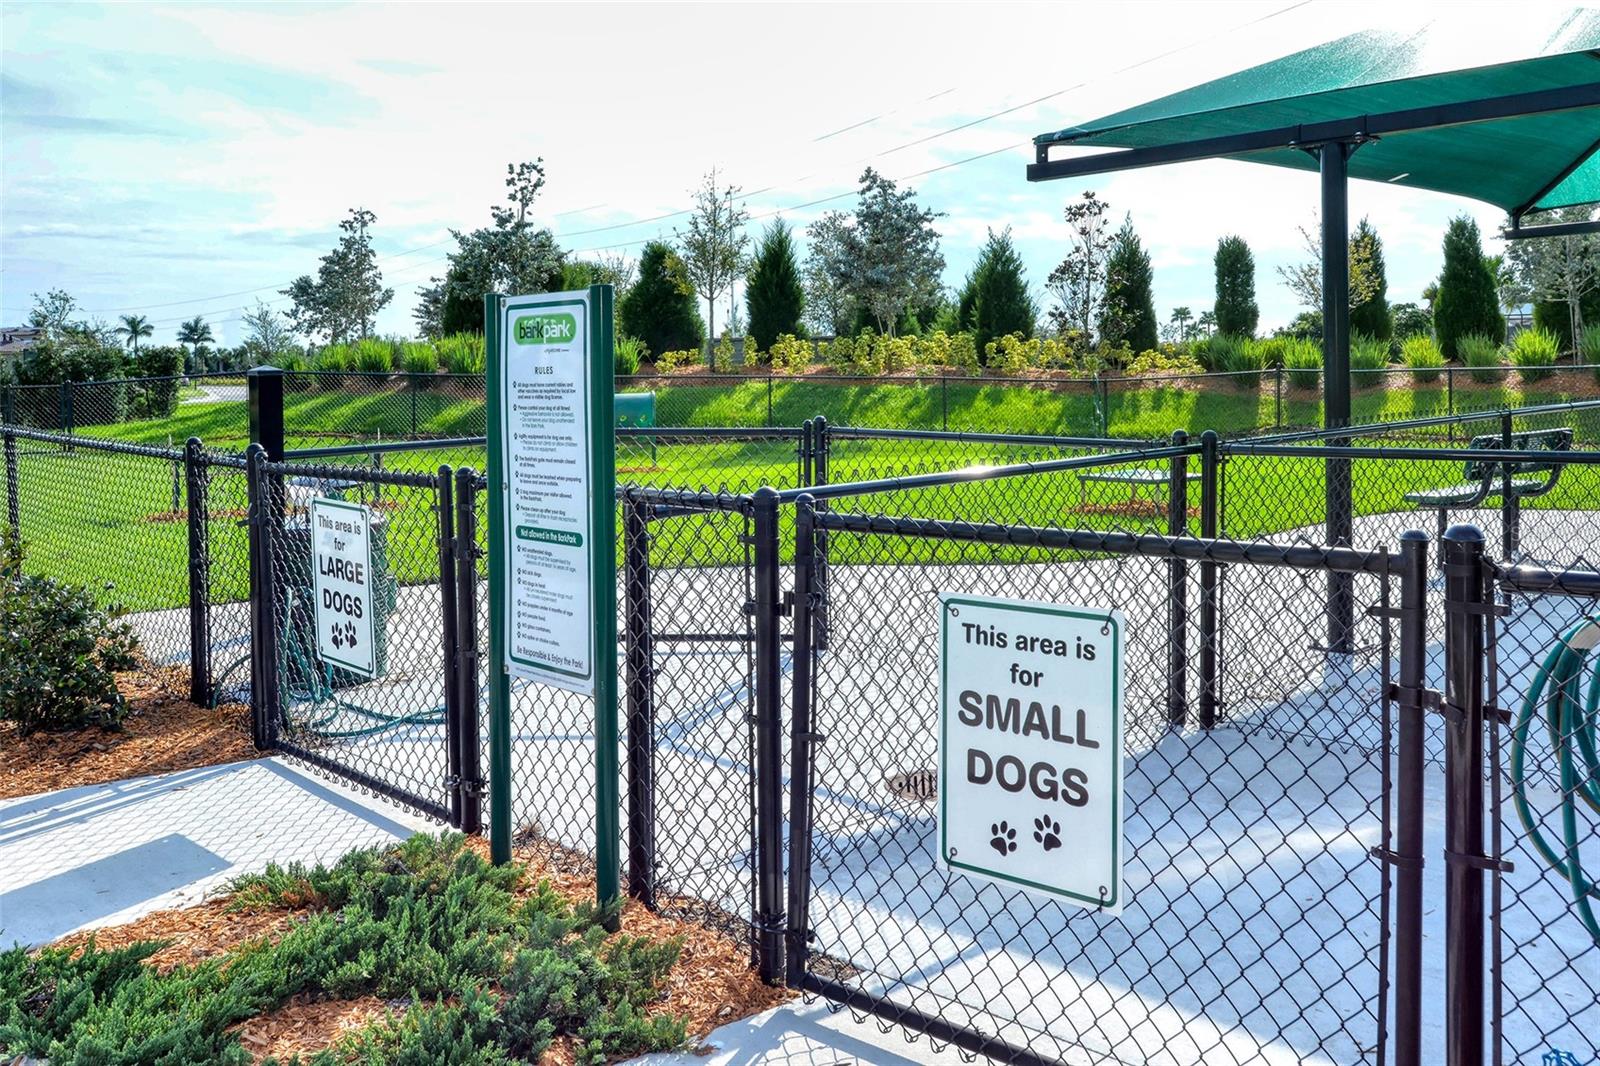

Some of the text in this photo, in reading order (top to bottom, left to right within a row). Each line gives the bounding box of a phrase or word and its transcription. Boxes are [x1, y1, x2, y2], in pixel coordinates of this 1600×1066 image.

[535, 366, 554, 375] RULES
[318, 514, 361, 535] This area is
[529, 530, 545, 539] allowed
[545, 532, 549, 540] in
[334, 538, 345, 551] for
[319, 554, 364, 585] LARGE
[323, 586, 363, 620] DOGS
[961, 622, 1096, 661] This area is
[517, 646, 522, 654] Be
[523, 647, 546, 660] Responsible
[548, 653, 550, 661] &
[551, 654, 563, 665] Enjoy
[1010, 663, 1044, 687] for
[958, 690, 1100, 750] SMALL
[967, 748, 1090, 808] DOGS
